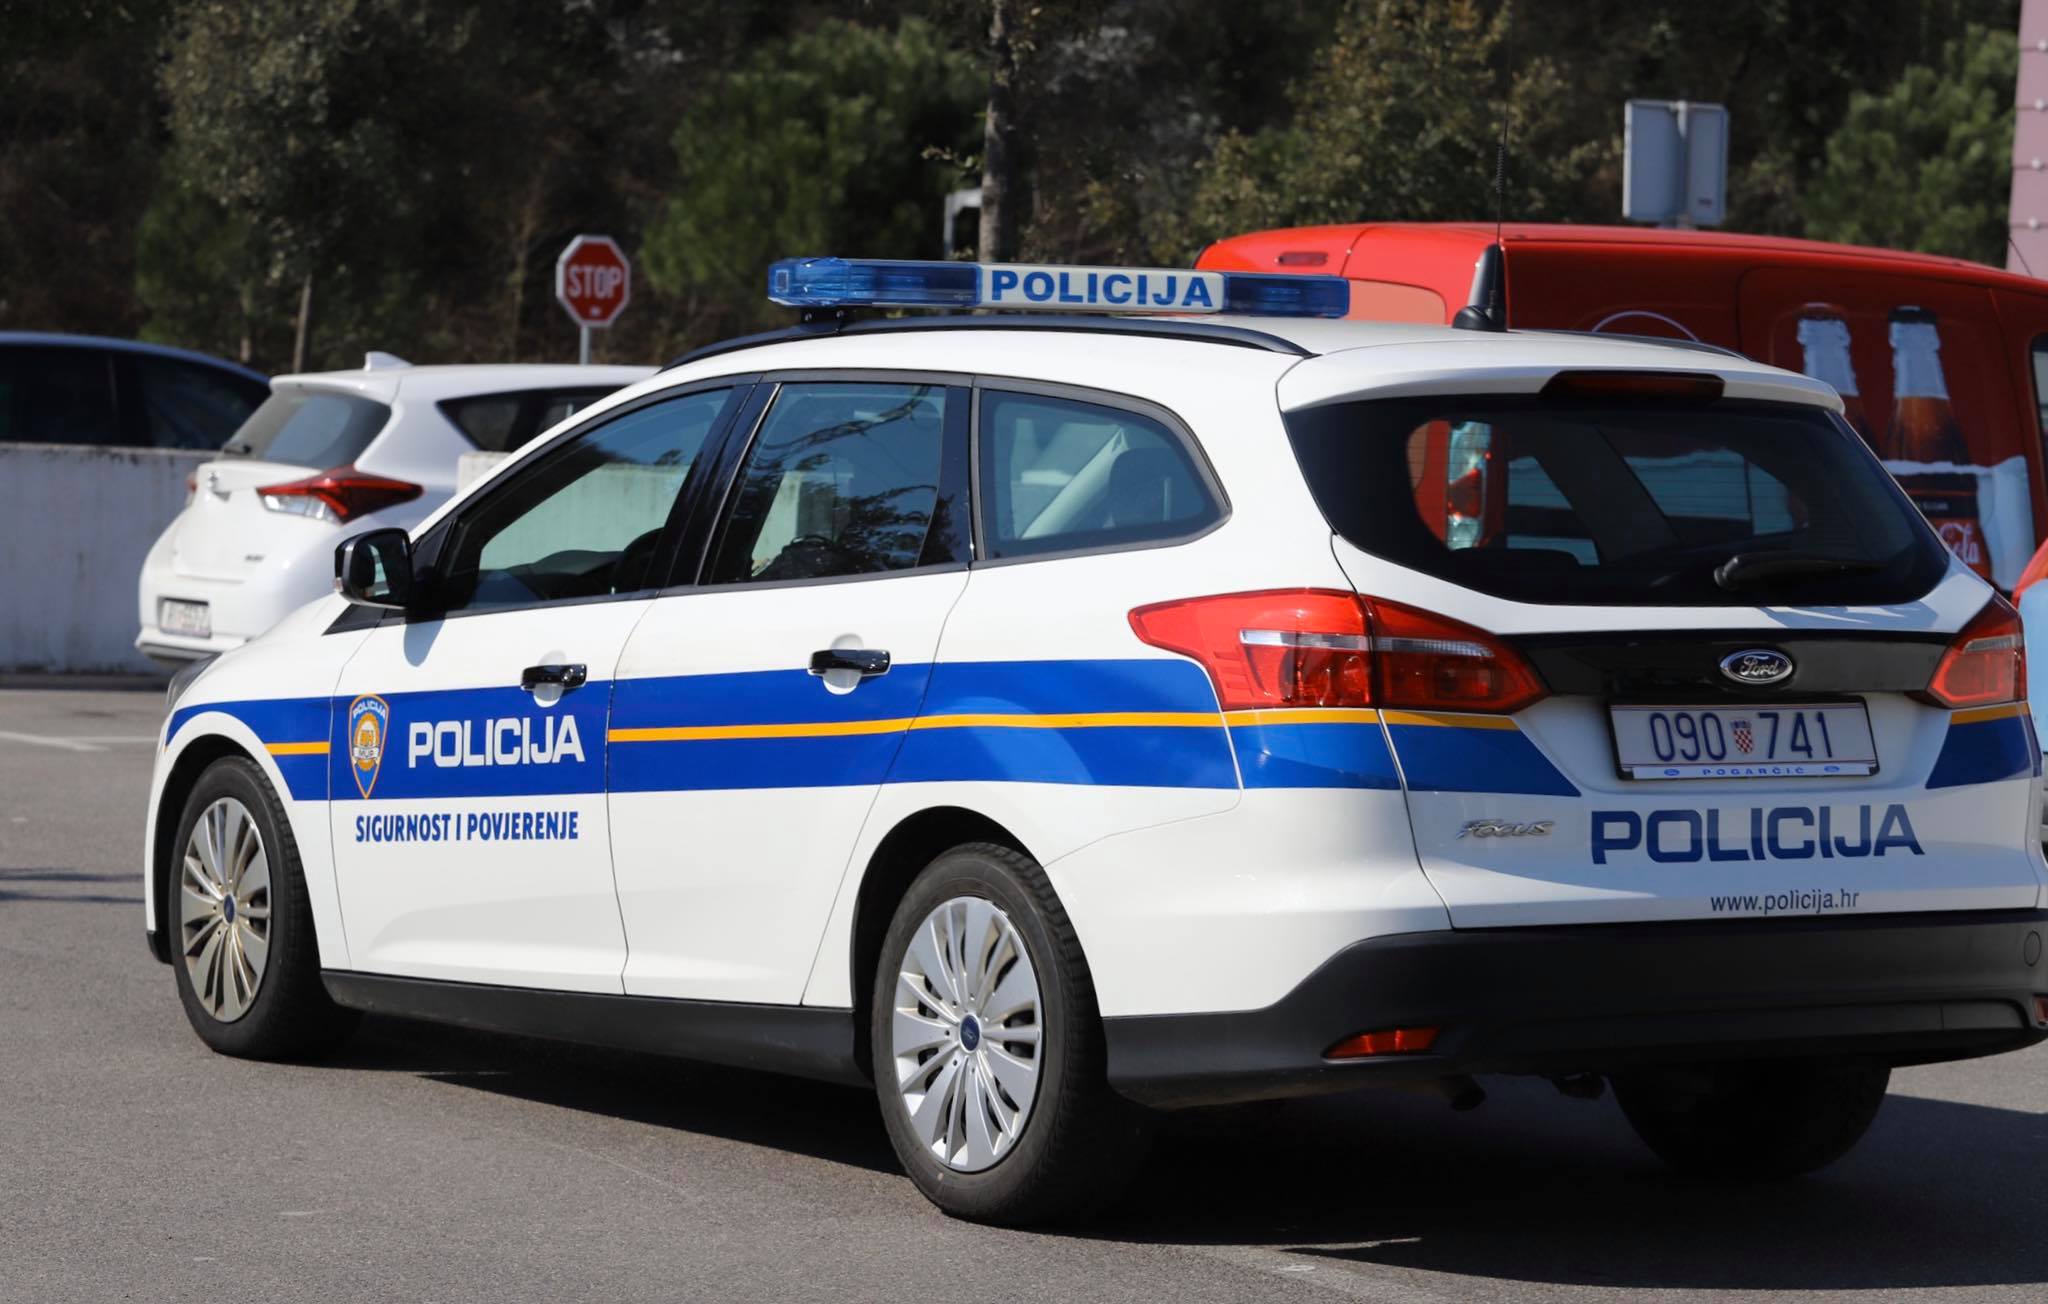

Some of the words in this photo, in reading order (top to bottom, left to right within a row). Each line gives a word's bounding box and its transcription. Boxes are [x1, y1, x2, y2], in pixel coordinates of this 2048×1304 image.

[567, 264, 622, 299] STOP
[991, 269, 1214, 308] POLICIJA
[1740, 654, 1781, 677] Ford
[408, 714, 586, 769] POLICIJA
[1648, 711, 1727, 762] 090
[1757, 711, 1833, 760] 741
[355, 813, 452, 843] SIGURNOST
[455, 812, 462, 841] I
[466, 810, 579, 841] POVJERENJE
[1591, 804, 1925, 865] POLICIJA
[1710, 888, 1860, 916] www.policija.hr
